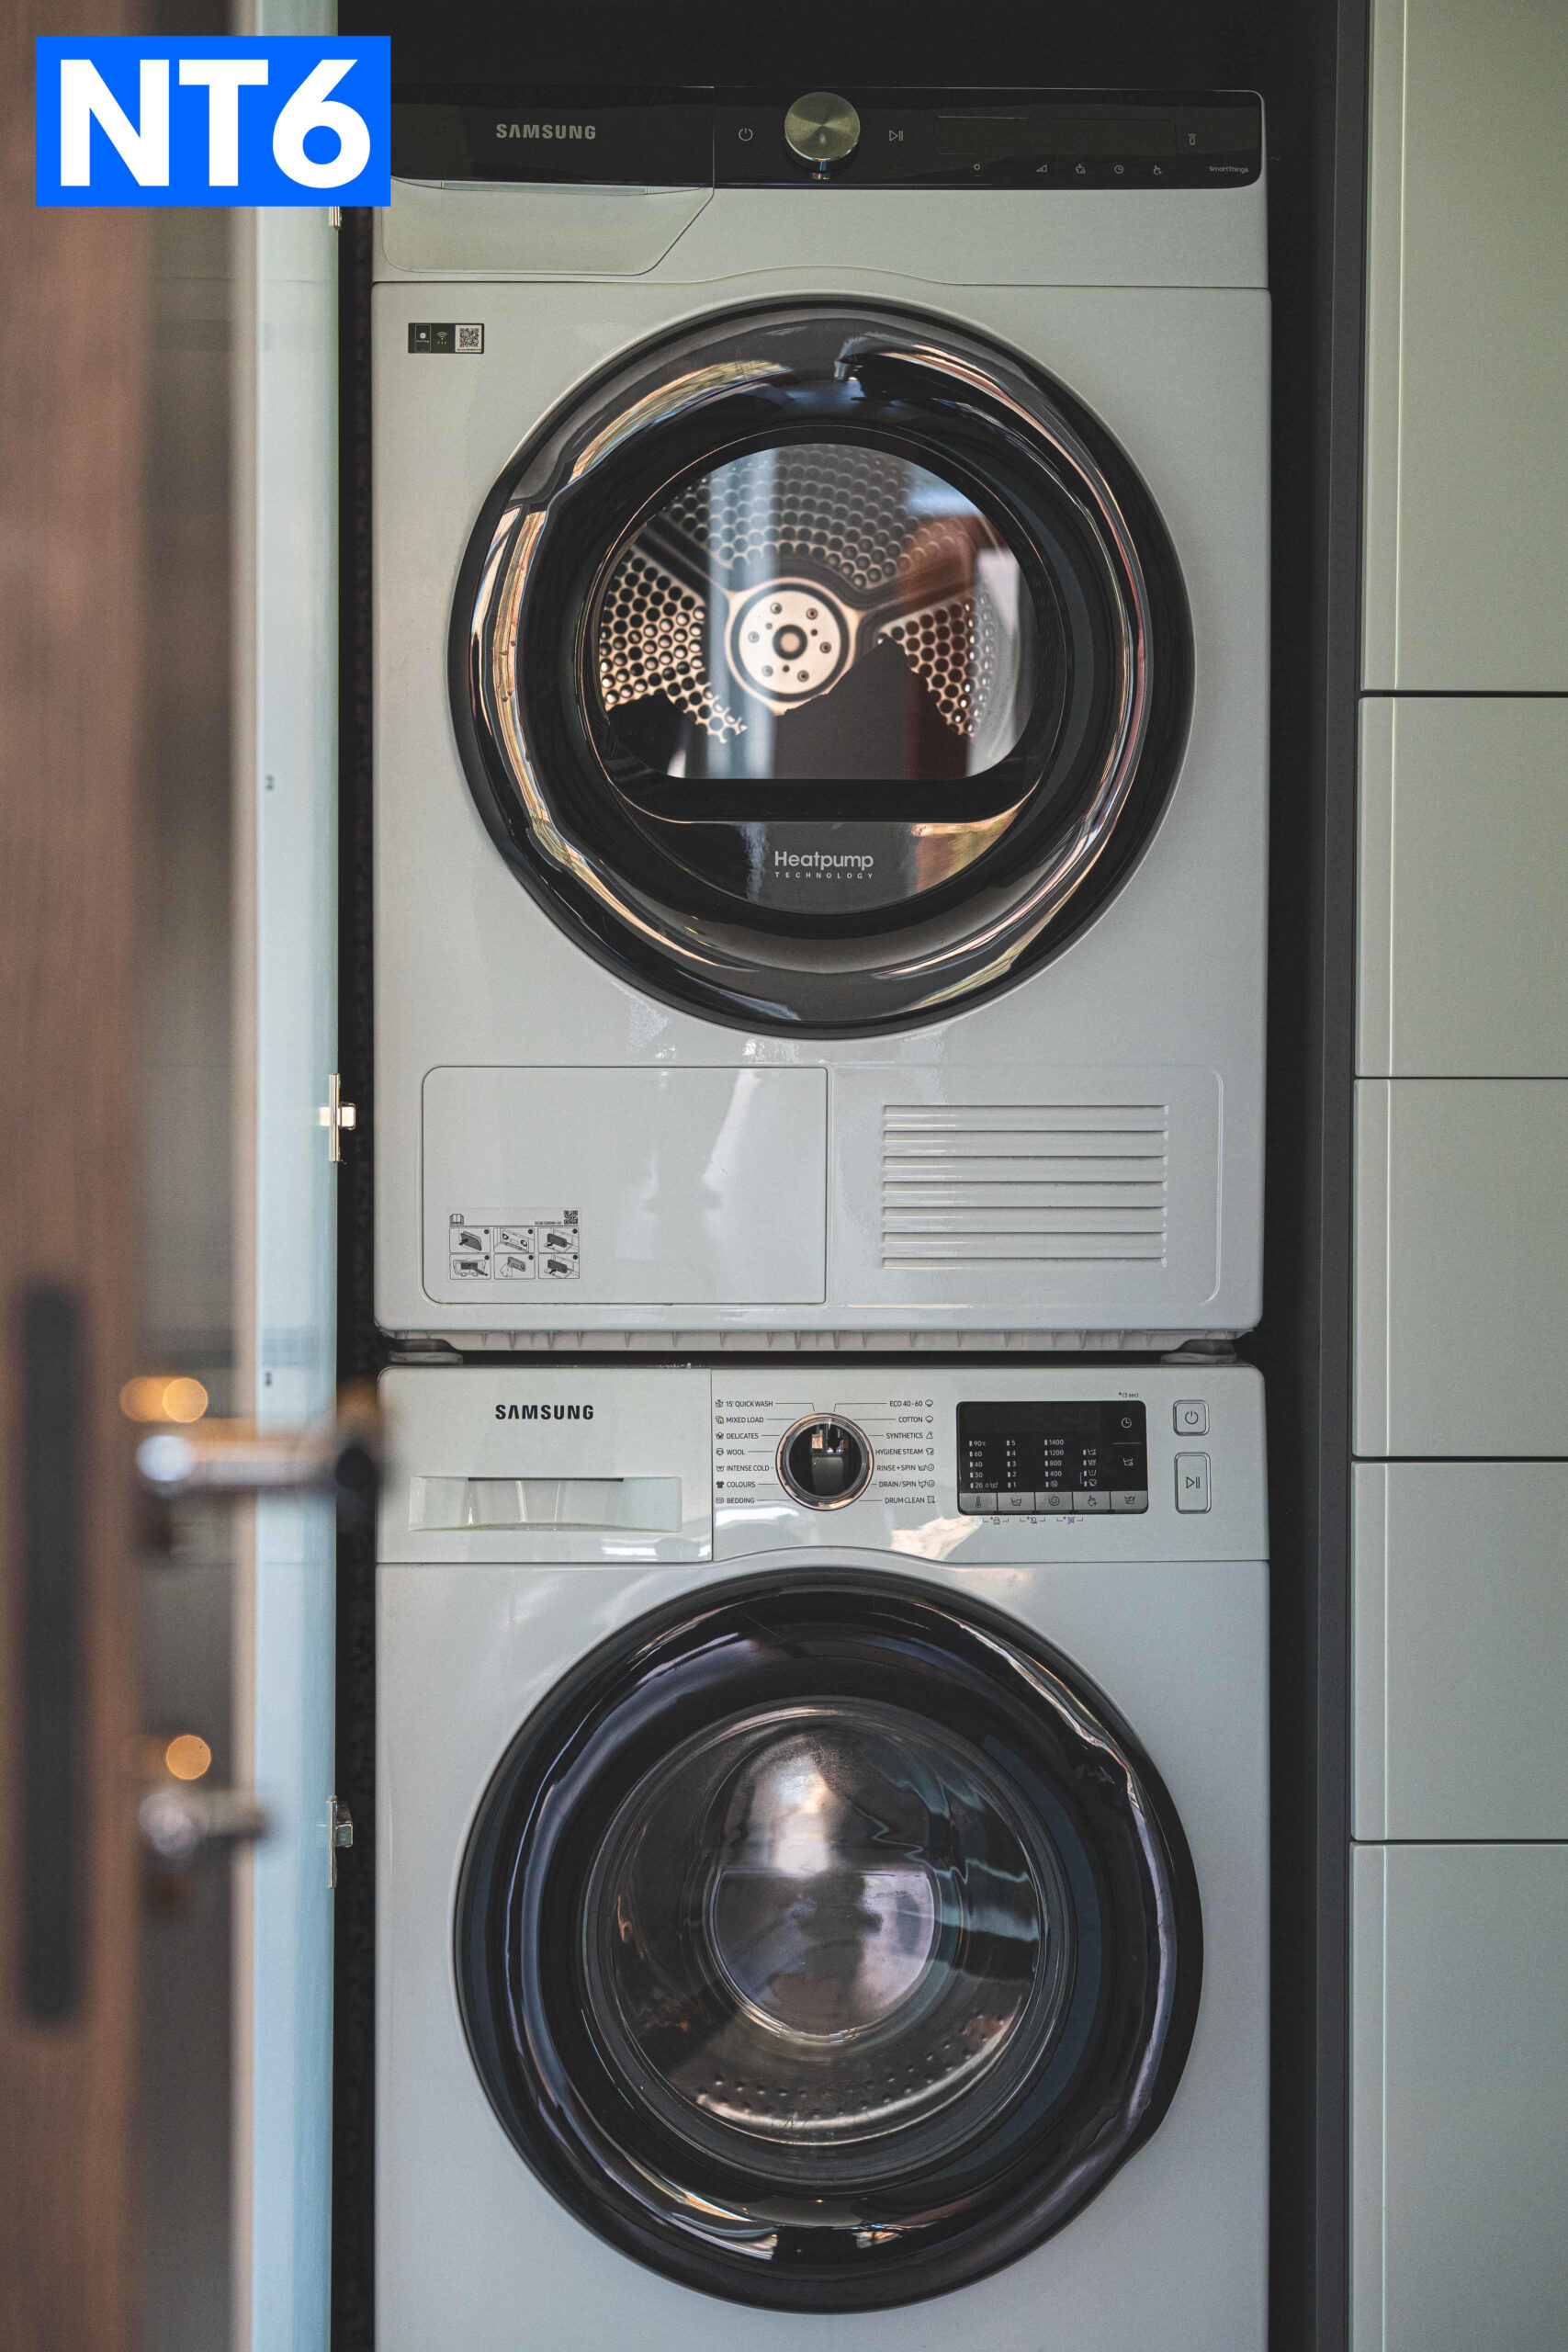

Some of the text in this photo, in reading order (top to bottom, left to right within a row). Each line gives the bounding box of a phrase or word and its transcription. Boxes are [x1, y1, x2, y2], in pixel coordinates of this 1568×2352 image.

[496, 123, 596, 140] SAMSUNG
[1208, 165, 1249, 175] SmartThings
[774, 851, 874, 871] Heatpump
[774, 871, 873, 879] TECHNOLOGY
[735, 1400, 754, 1408] QUICK
[495, 1404, 594, 1420] SAMSUNG
